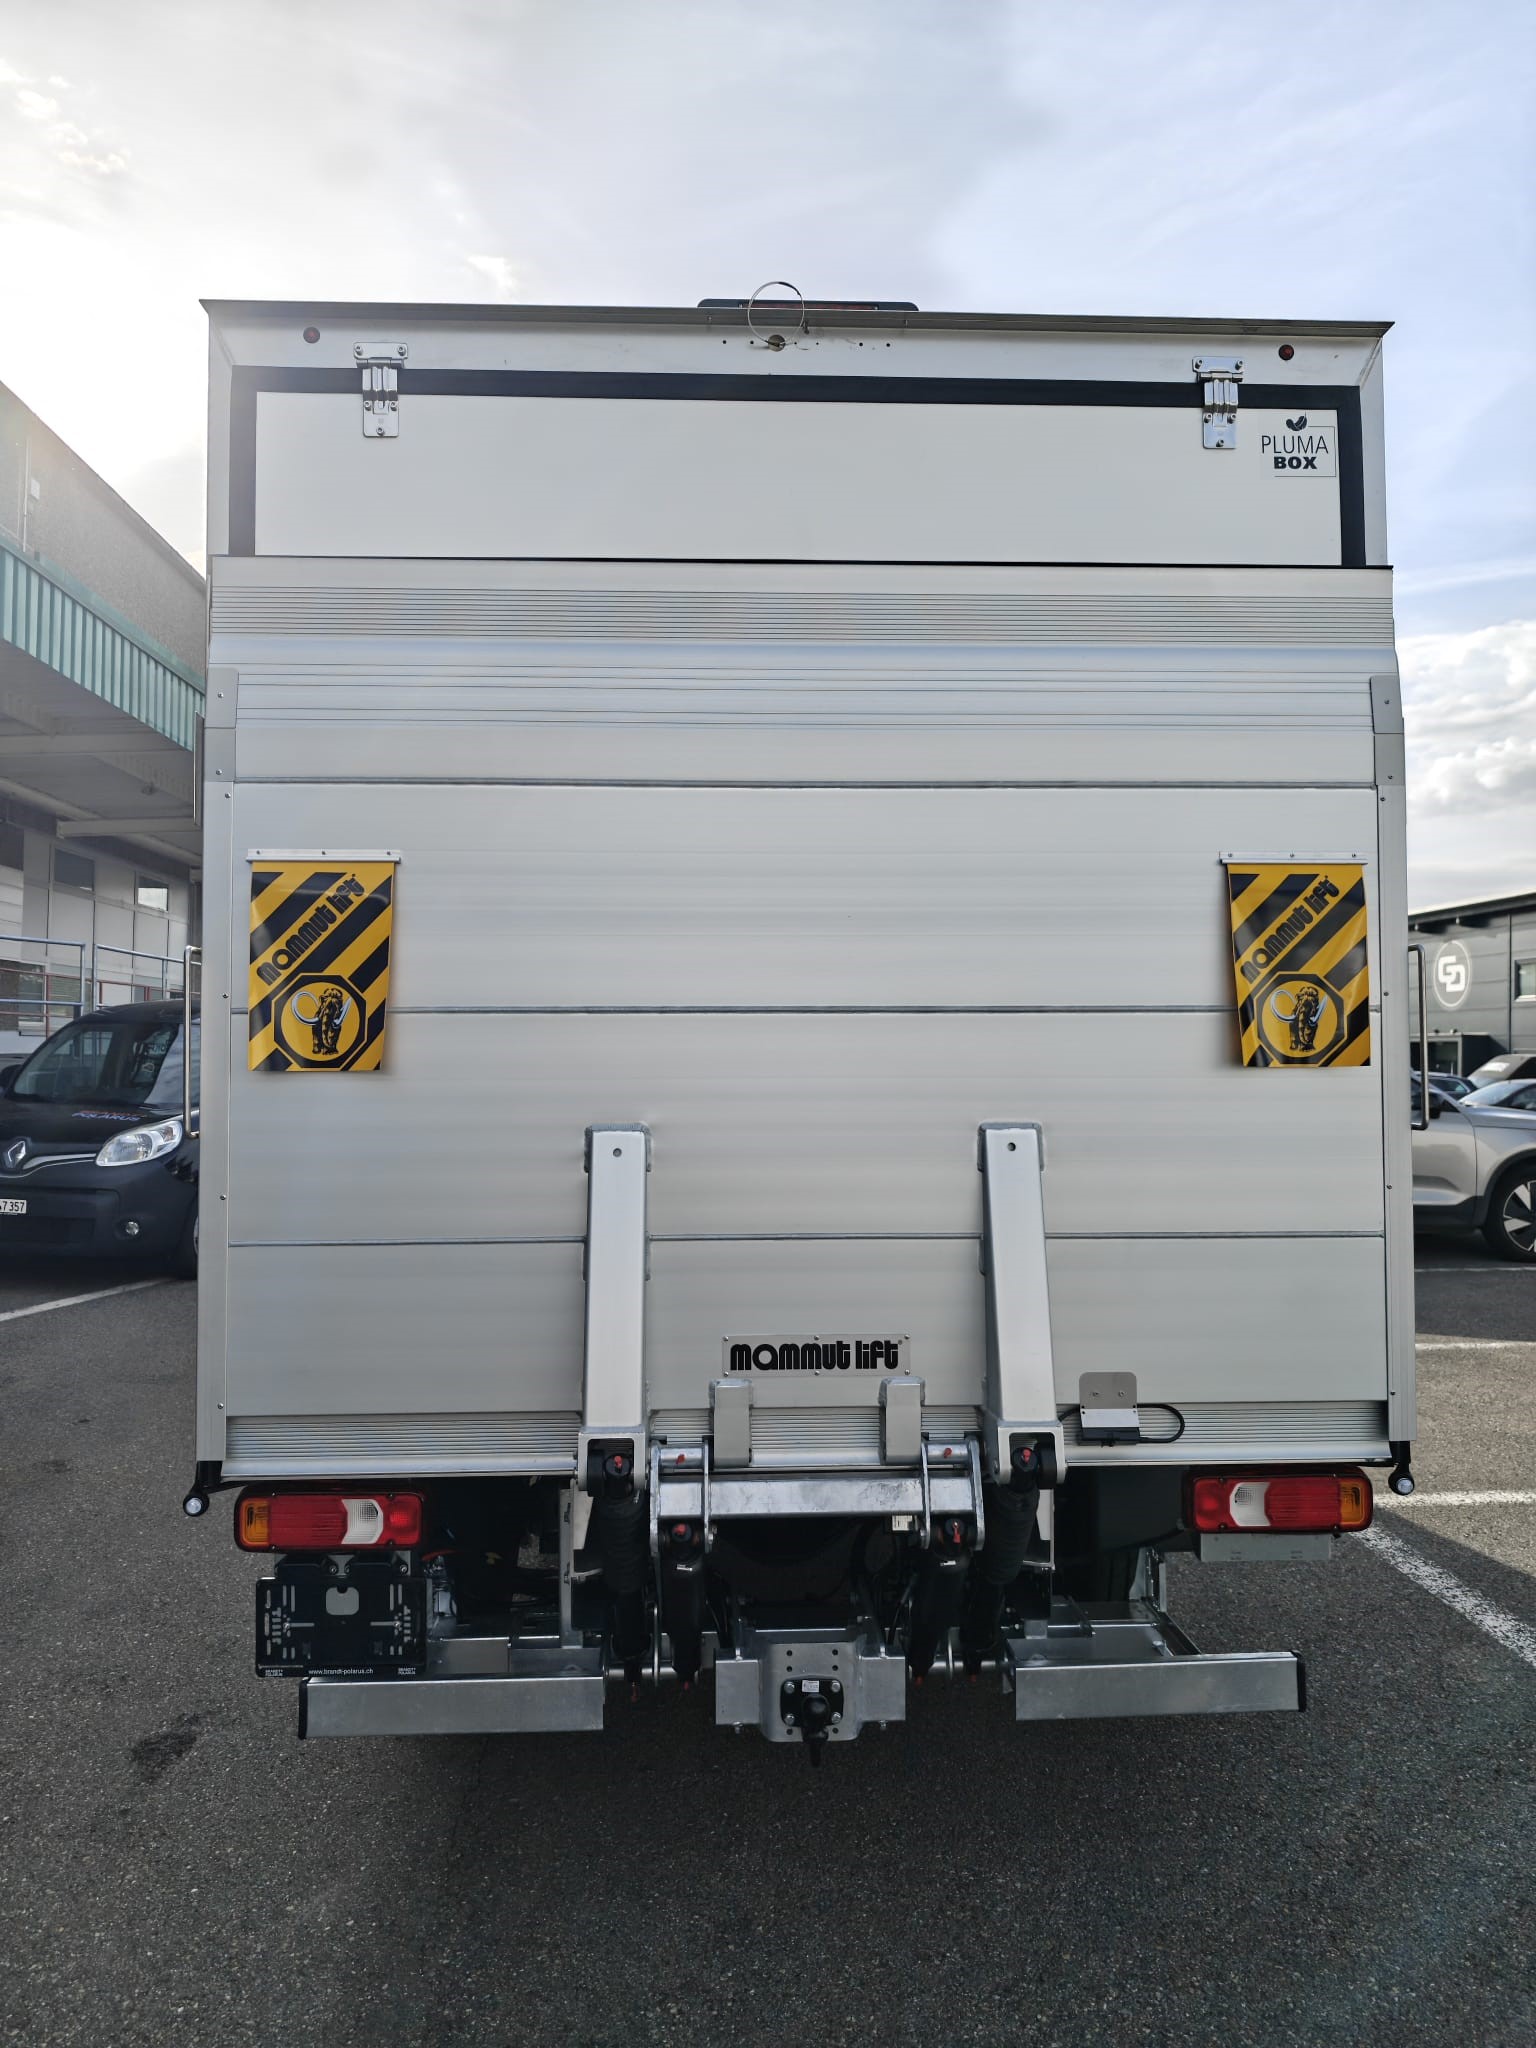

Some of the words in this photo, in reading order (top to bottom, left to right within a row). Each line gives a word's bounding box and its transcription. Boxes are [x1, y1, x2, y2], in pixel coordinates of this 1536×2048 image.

[1261, 435, 1329, 454] PLUMA
[1273, 456, 1318, 470] BOX
[256, 904, 338, 986] mammut
[326, 876, 366, 915] lift
[1240, 904, 1314, 985] mammut
[1305, 877, 1341, 915] lift
[729, 1340, 851, 1371] mammut
[855, 1339, 899, 1370] lift
